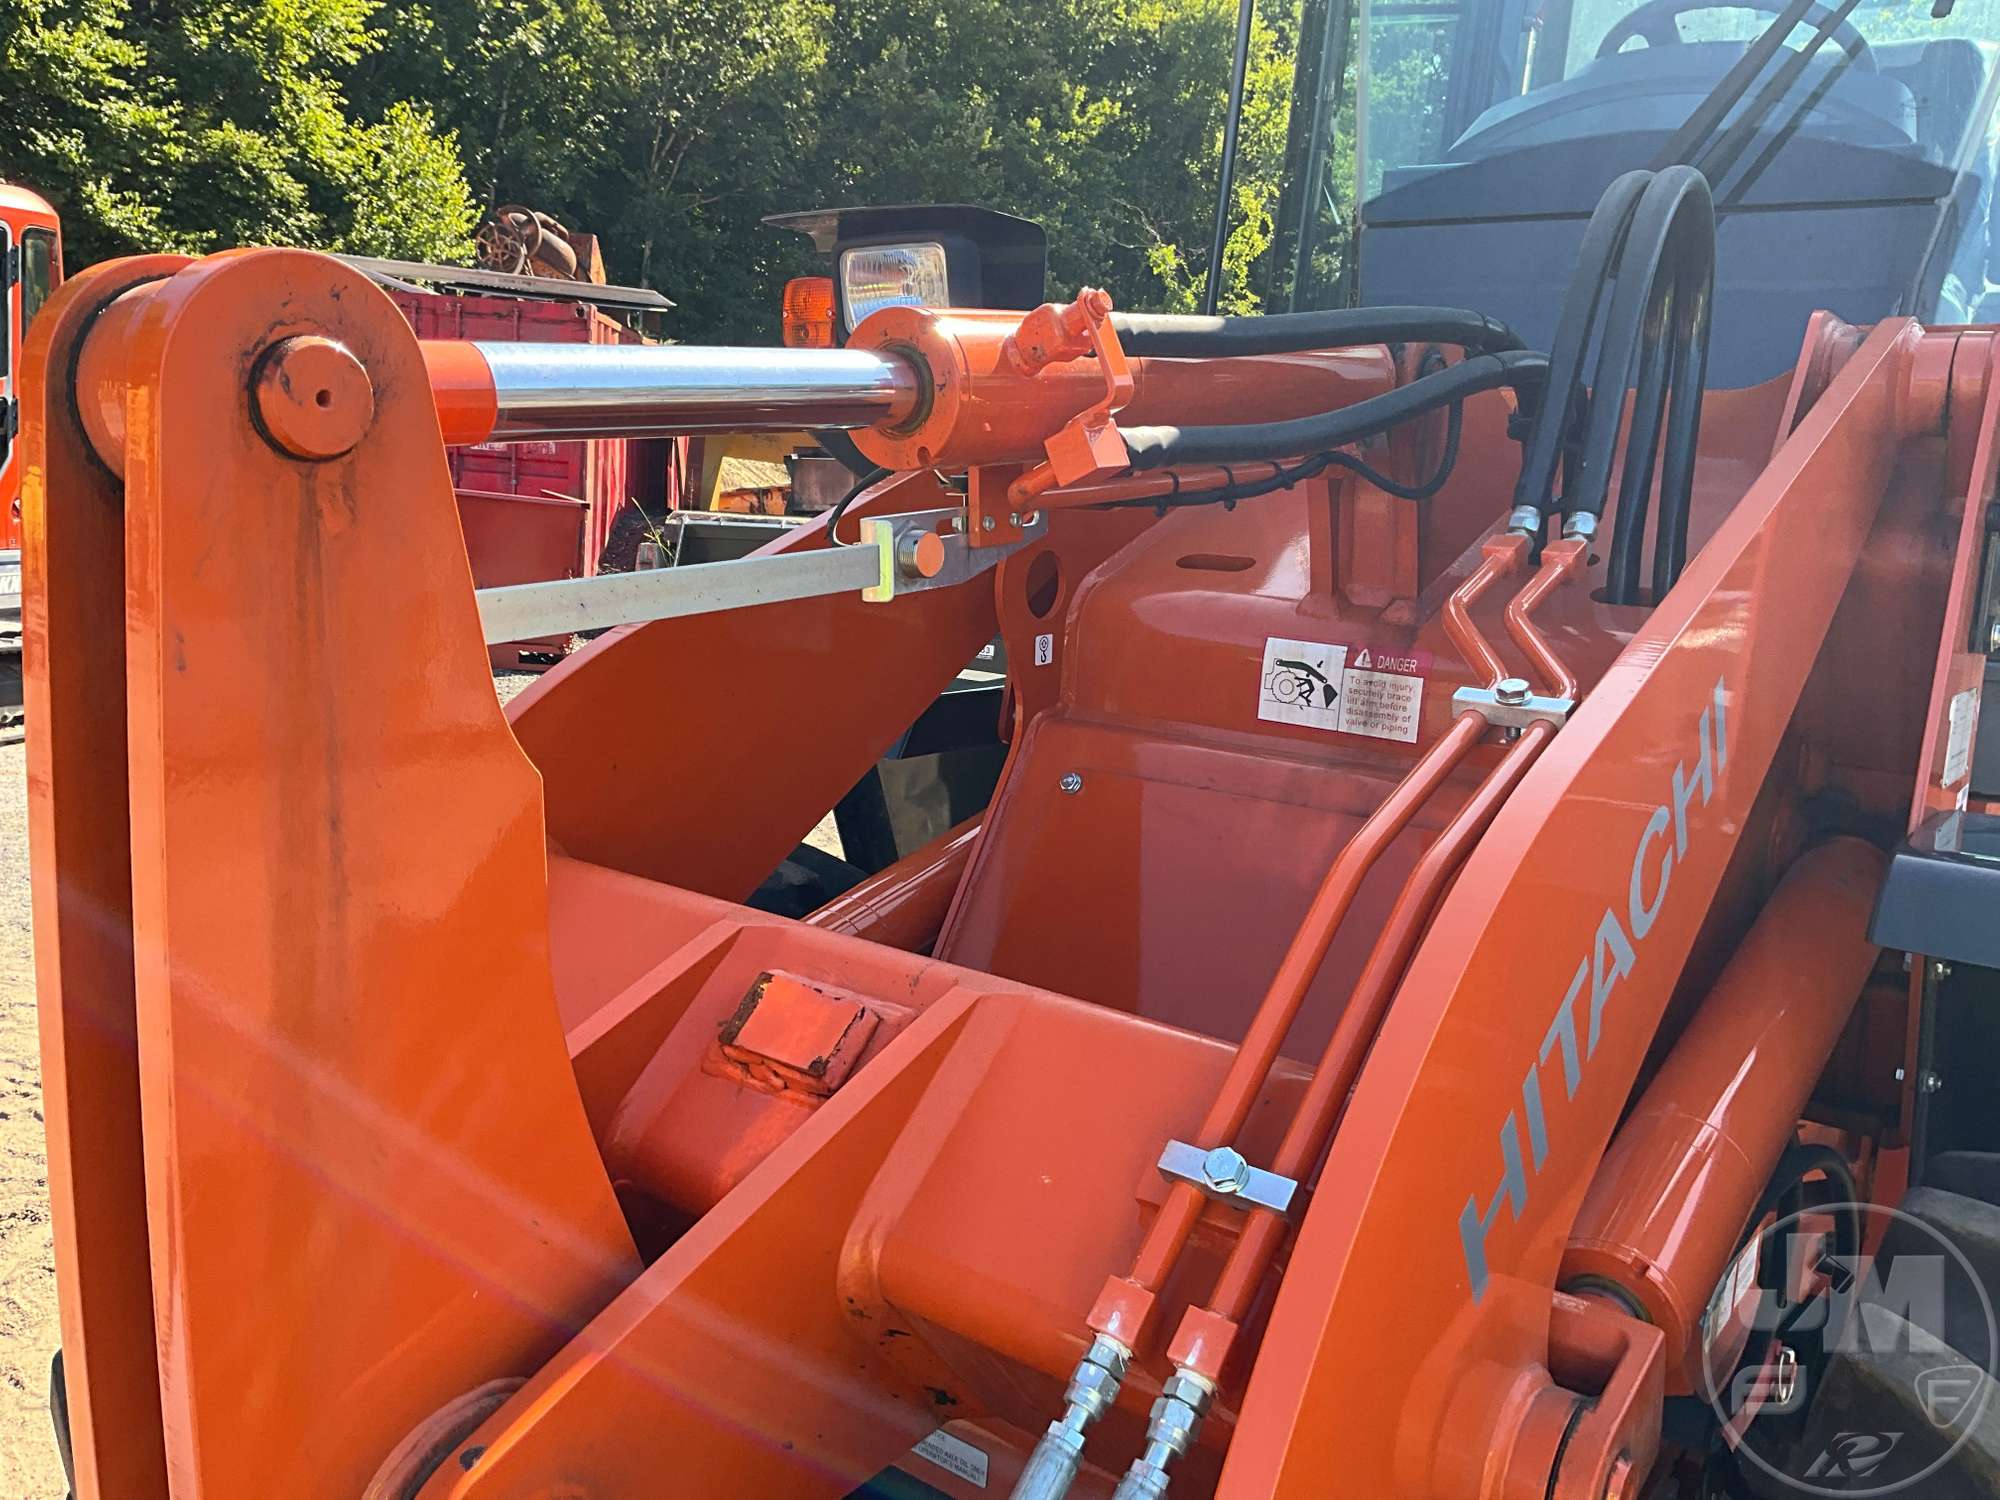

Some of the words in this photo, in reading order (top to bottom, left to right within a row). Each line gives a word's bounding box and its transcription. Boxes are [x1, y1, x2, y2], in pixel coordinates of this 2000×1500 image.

[1377, 655, 1417, 673] DANGER
[1350, 676, 1361, 685] To
[1363, 679, 1387, 688] avoid
[1348, 687, 1384, 699] securely
[1387, 692, 1412, 702] brace
[1347, 695, 1358, 705] lift
[1360, 699, 1378, 707] arm
[1380, 701, 1408, 712] before
[1346, 707, 1400, 722] disassembly
[1402, 715, 1412, 723] of
[1345, 719, 1368, 728] valve
[1381, 723, 1408, 735] piping
[1458, 675, 1729, 1307] HITACHI
